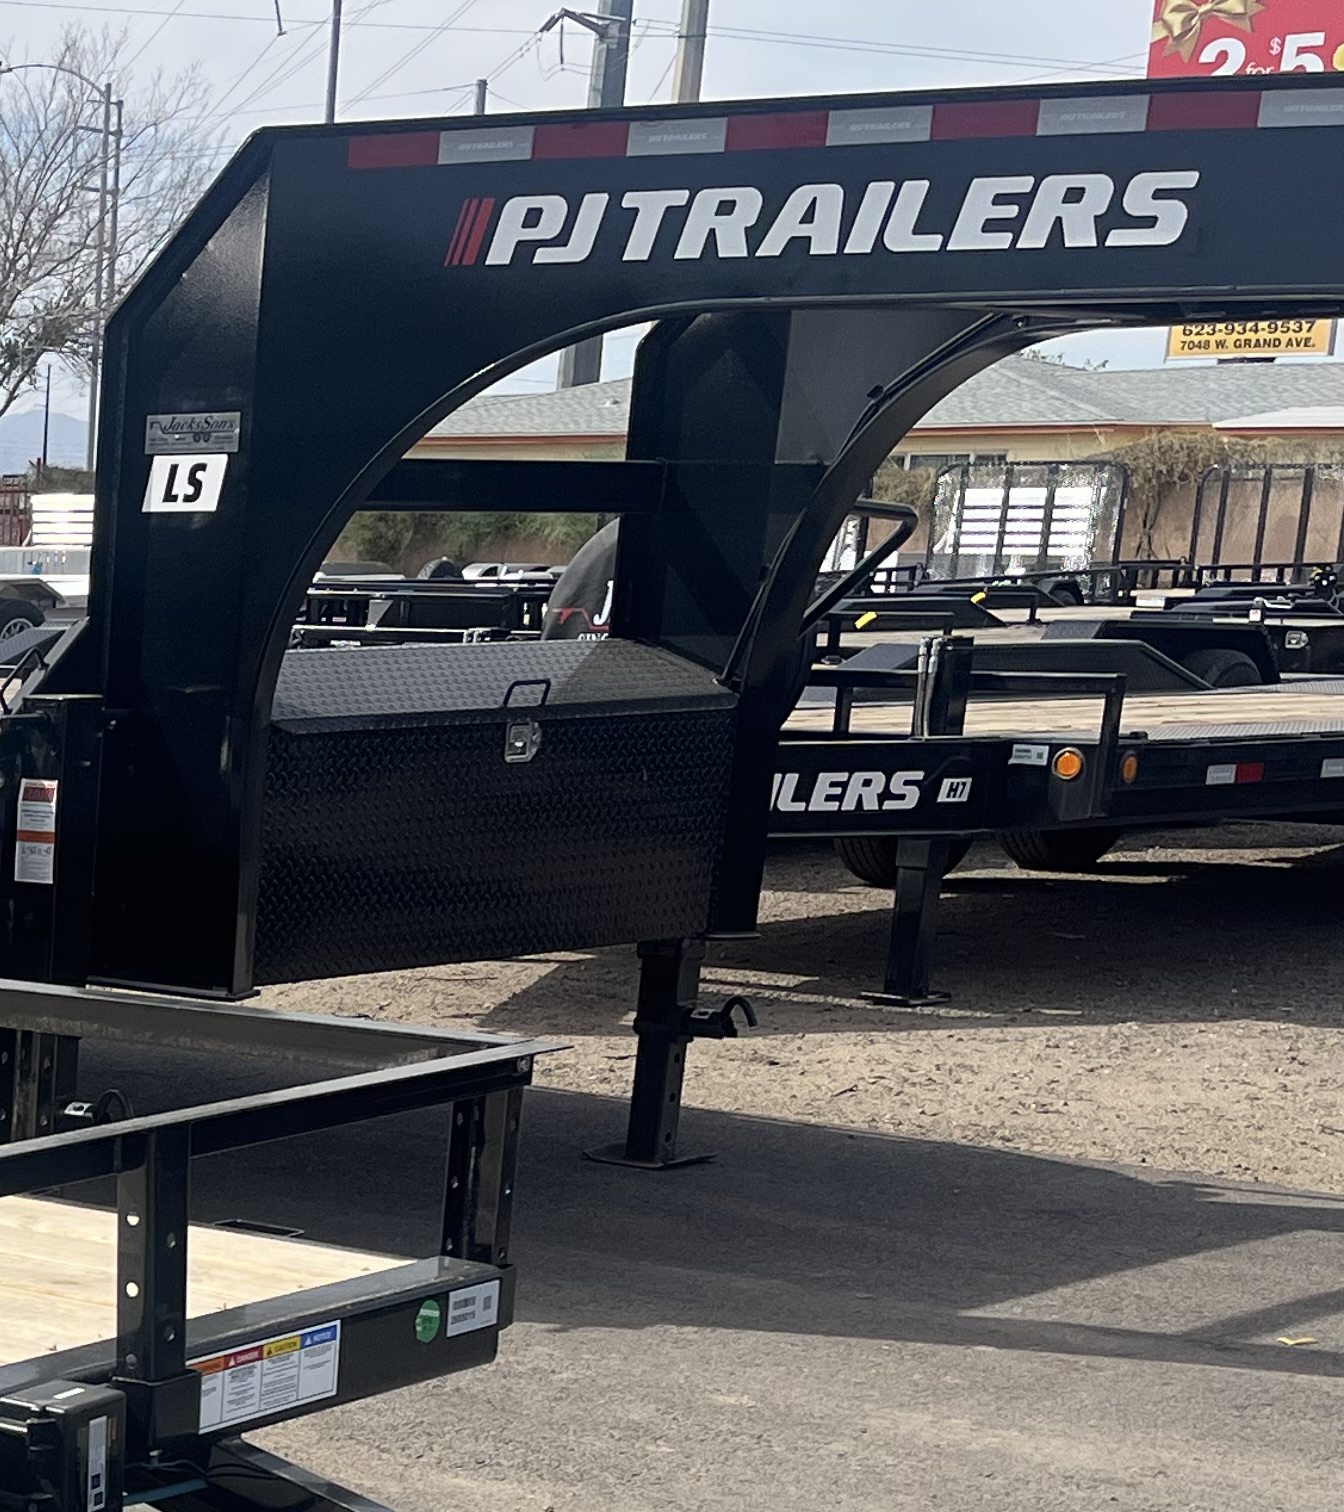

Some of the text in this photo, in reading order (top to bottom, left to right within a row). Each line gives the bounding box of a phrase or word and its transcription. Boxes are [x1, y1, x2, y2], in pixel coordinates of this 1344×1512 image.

[1199, 37, 1246, 76] 2
[484, 171, 1200, 265] PJ TRAILERS
[1180, 337, 1316, 351] 7048 W. GRAND AVE.
[1182, 320, 1316, 337] 623-934-9537
[162, 462, 208, 503] LS
[769, 770, 925, 811] LERS
